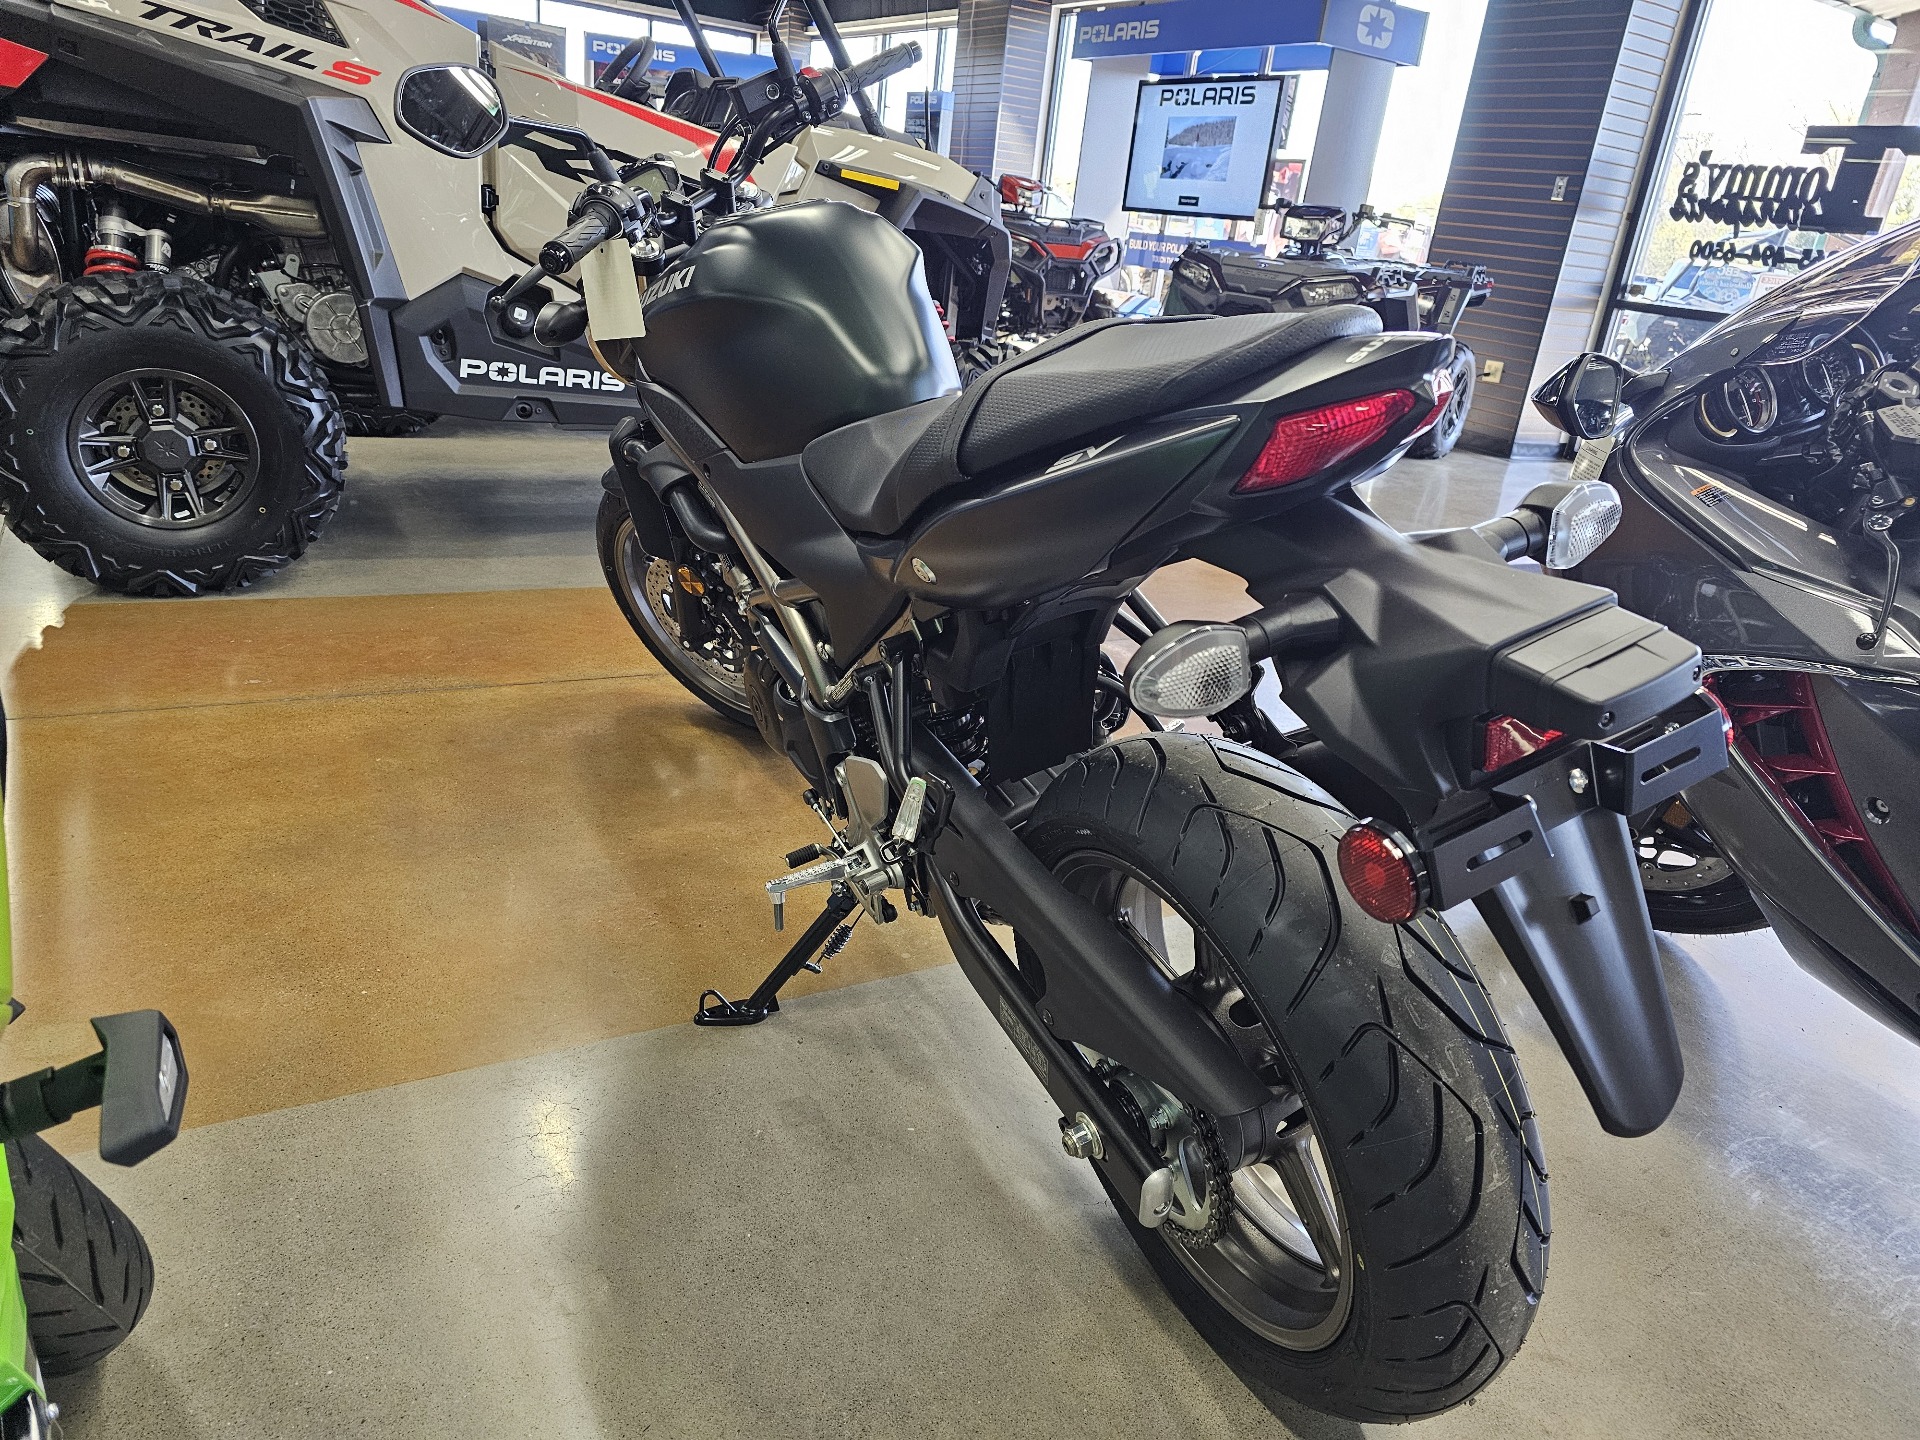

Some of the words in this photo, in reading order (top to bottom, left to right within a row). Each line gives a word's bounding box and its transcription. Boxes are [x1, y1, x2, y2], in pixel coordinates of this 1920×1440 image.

[138, 0, 318, 71] TRAIL
[321, 60, 383, 86] S
[502, 33, 553, 49] XPEDITION
[1078, 19, 1161, 44] POLARIS
[592, 39, 676, 63] POIS
[1159, 85, 1257, 107] POLARIS
[1129, 238, 1149, 251] BUILD
[1149, 240, 1167, 253] YOUR
[1166, 242, 1189, 256] POLA
[640, 265, 697, 309] UZUKI
[459, 358, 626, 392] POLARIS
[1044, 434, 1127, 475] SV
